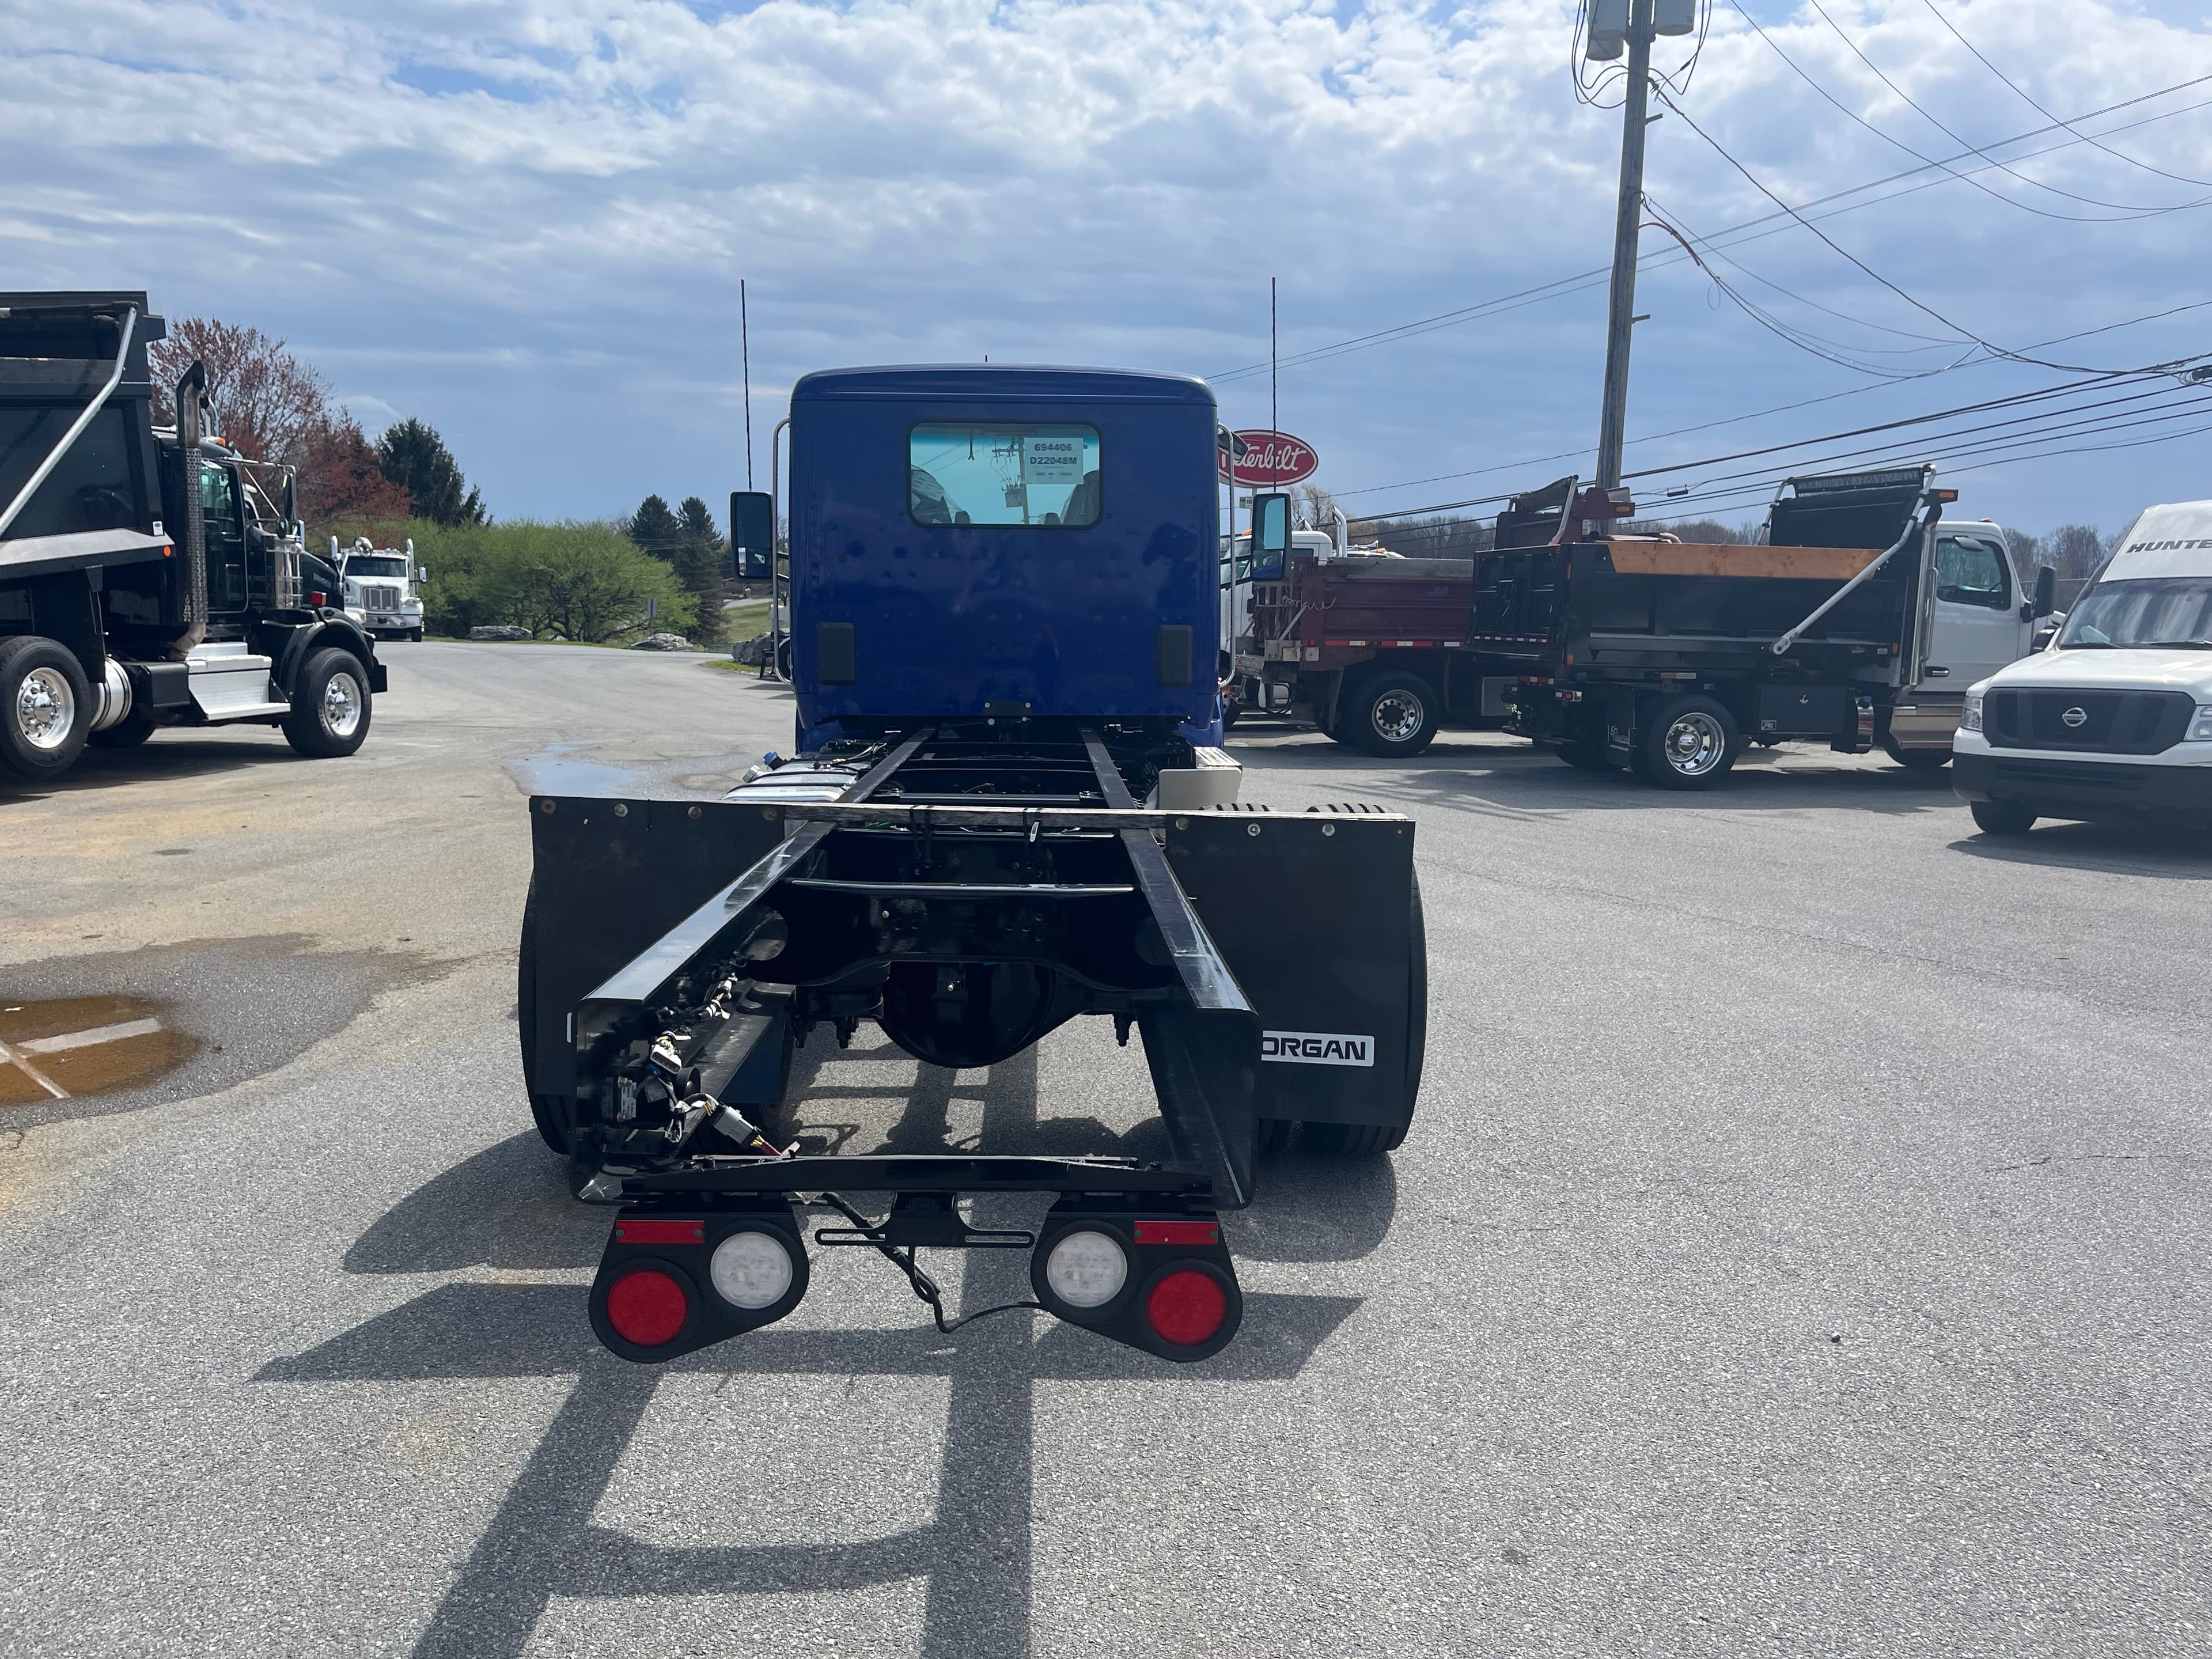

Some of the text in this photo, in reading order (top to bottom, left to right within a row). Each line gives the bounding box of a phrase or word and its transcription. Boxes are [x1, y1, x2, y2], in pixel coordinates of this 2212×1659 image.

[1221, 443, 1306, 471] terbilt
[2126, 539, 2212, 553] HUNTE
[1262, 1037, 1366, 1060] ORGAN
